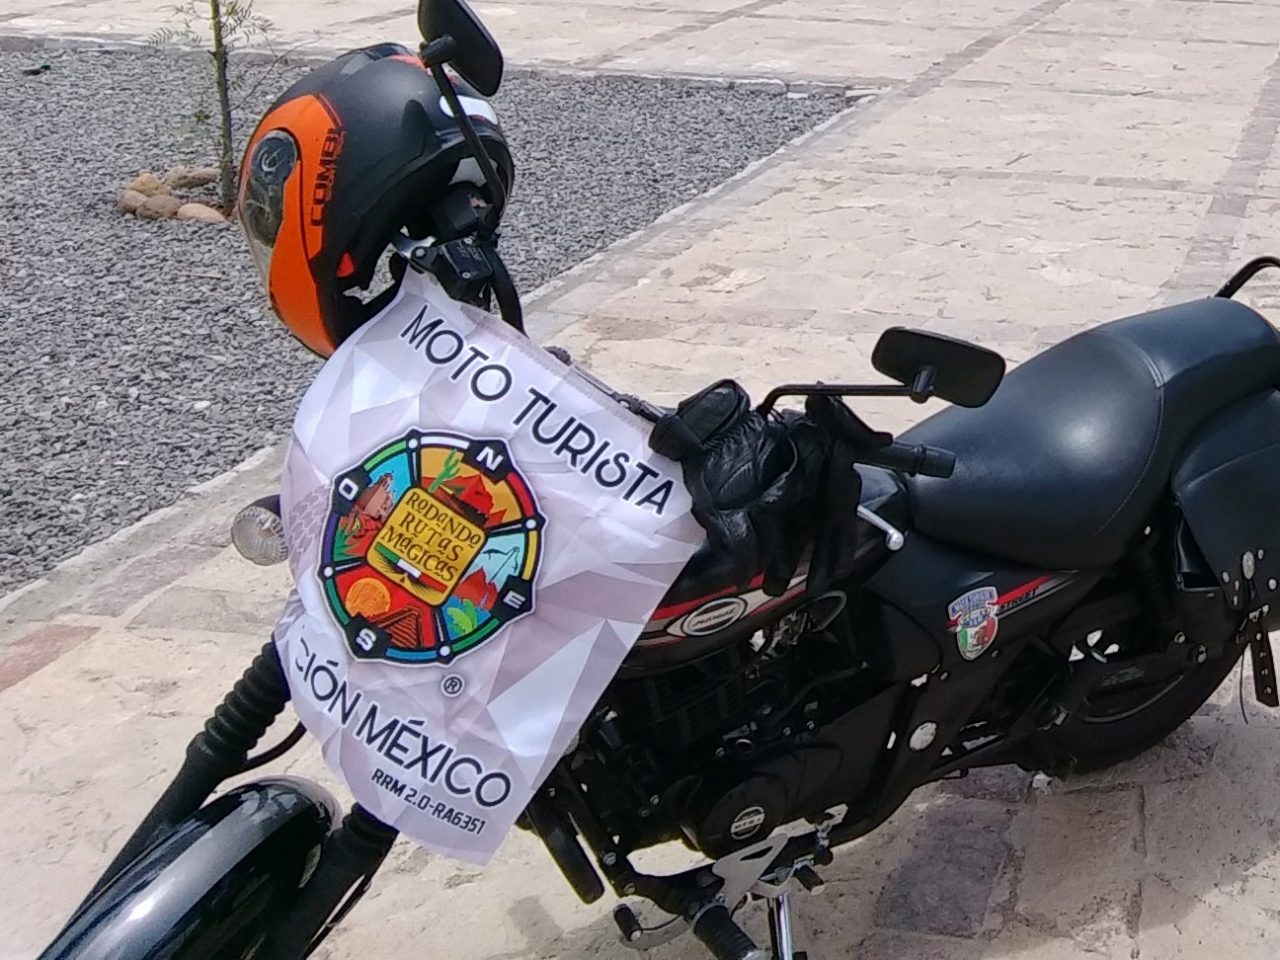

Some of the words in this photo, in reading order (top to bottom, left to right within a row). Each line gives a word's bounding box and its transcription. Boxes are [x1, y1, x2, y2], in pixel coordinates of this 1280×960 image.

[400, 304, 512, 402] MOTO
[512, 387, 674, 516] TURISTA
[475, 446, 504, 471] N
[503, 589, 526, 610] E
[355, 627, 377, 652] S
[355, 704, 511, 808] MÉXICO
[371, 768, 407, 798] RRM
[403, 787, 486, 836] 2.0-RA6351
